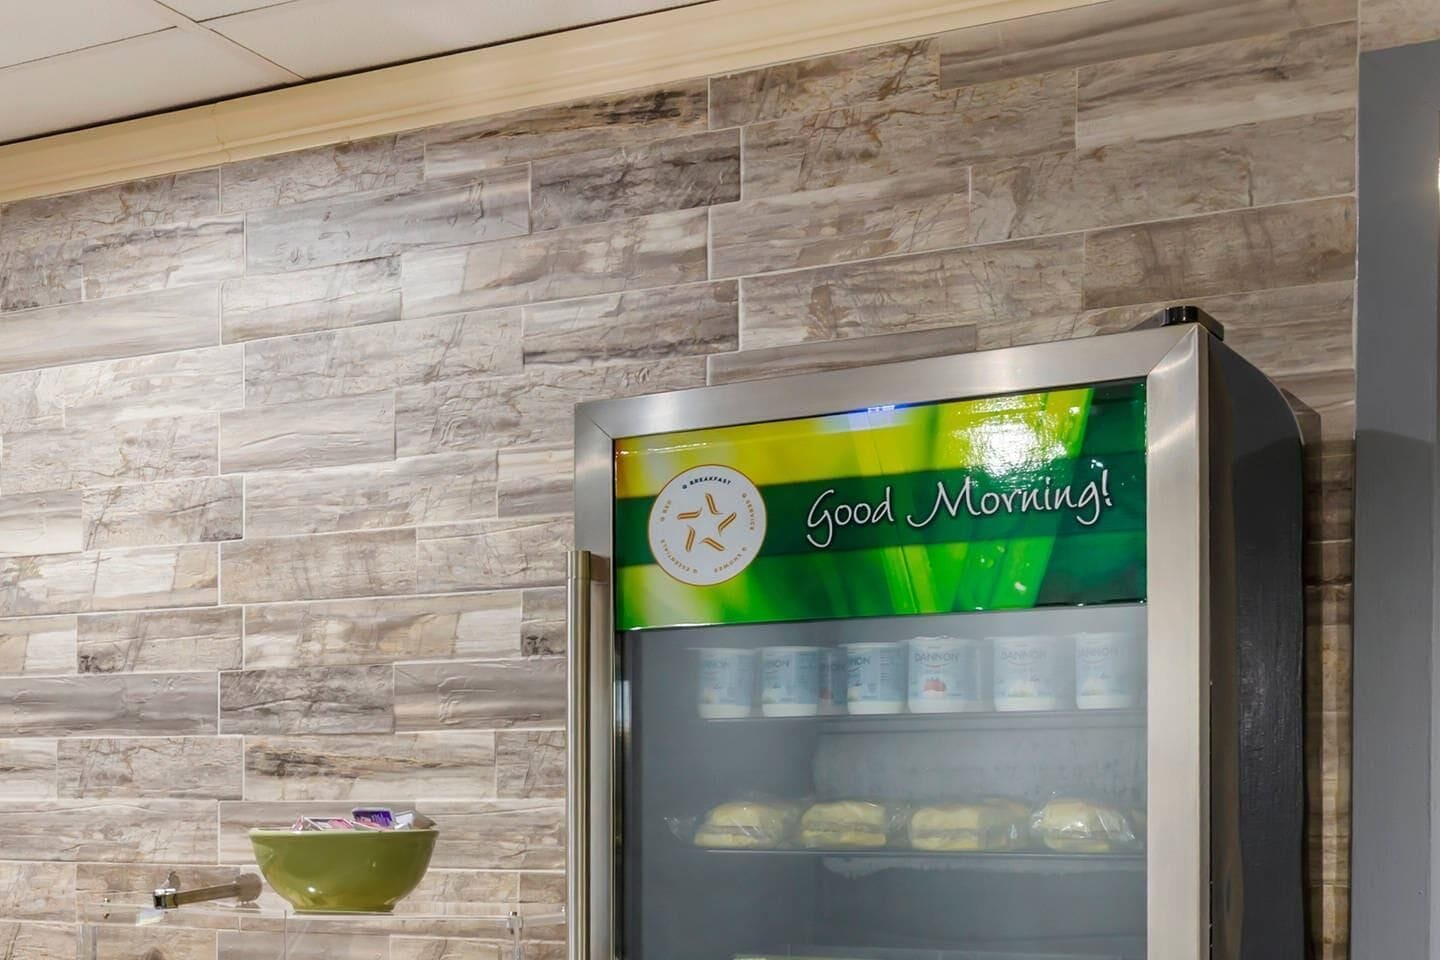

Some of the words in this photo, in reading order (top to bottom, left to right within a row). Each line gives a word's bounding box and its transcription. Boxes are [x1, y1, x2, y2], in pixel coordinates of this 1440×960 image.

[689, 476, 732, 486] BREAKFAST
[805, 485, 895, 548] Good
[906, 468, 1113, 527] Morning!
